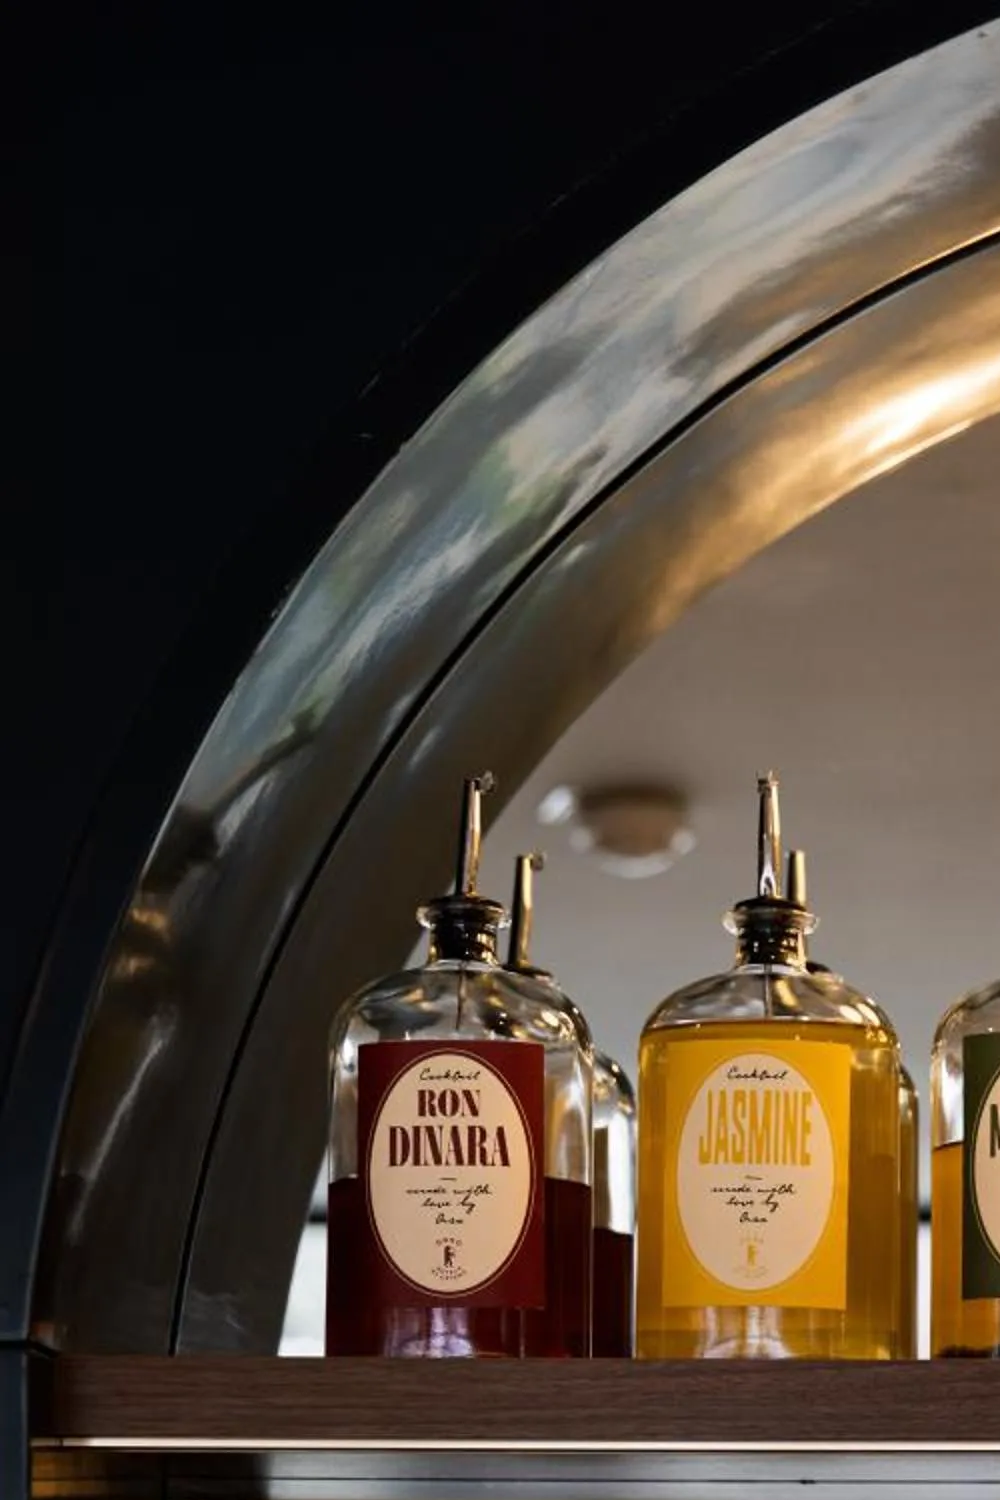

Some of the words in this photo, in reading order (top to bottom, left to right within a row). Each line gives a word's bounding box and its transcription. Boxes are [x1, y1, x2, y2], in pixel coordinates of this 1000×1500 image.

[417, 1088, 480, 1117] RON
[388, 1125, 511, 1167] DINARA
[698, 1089, 812, 1166] JASMINE
